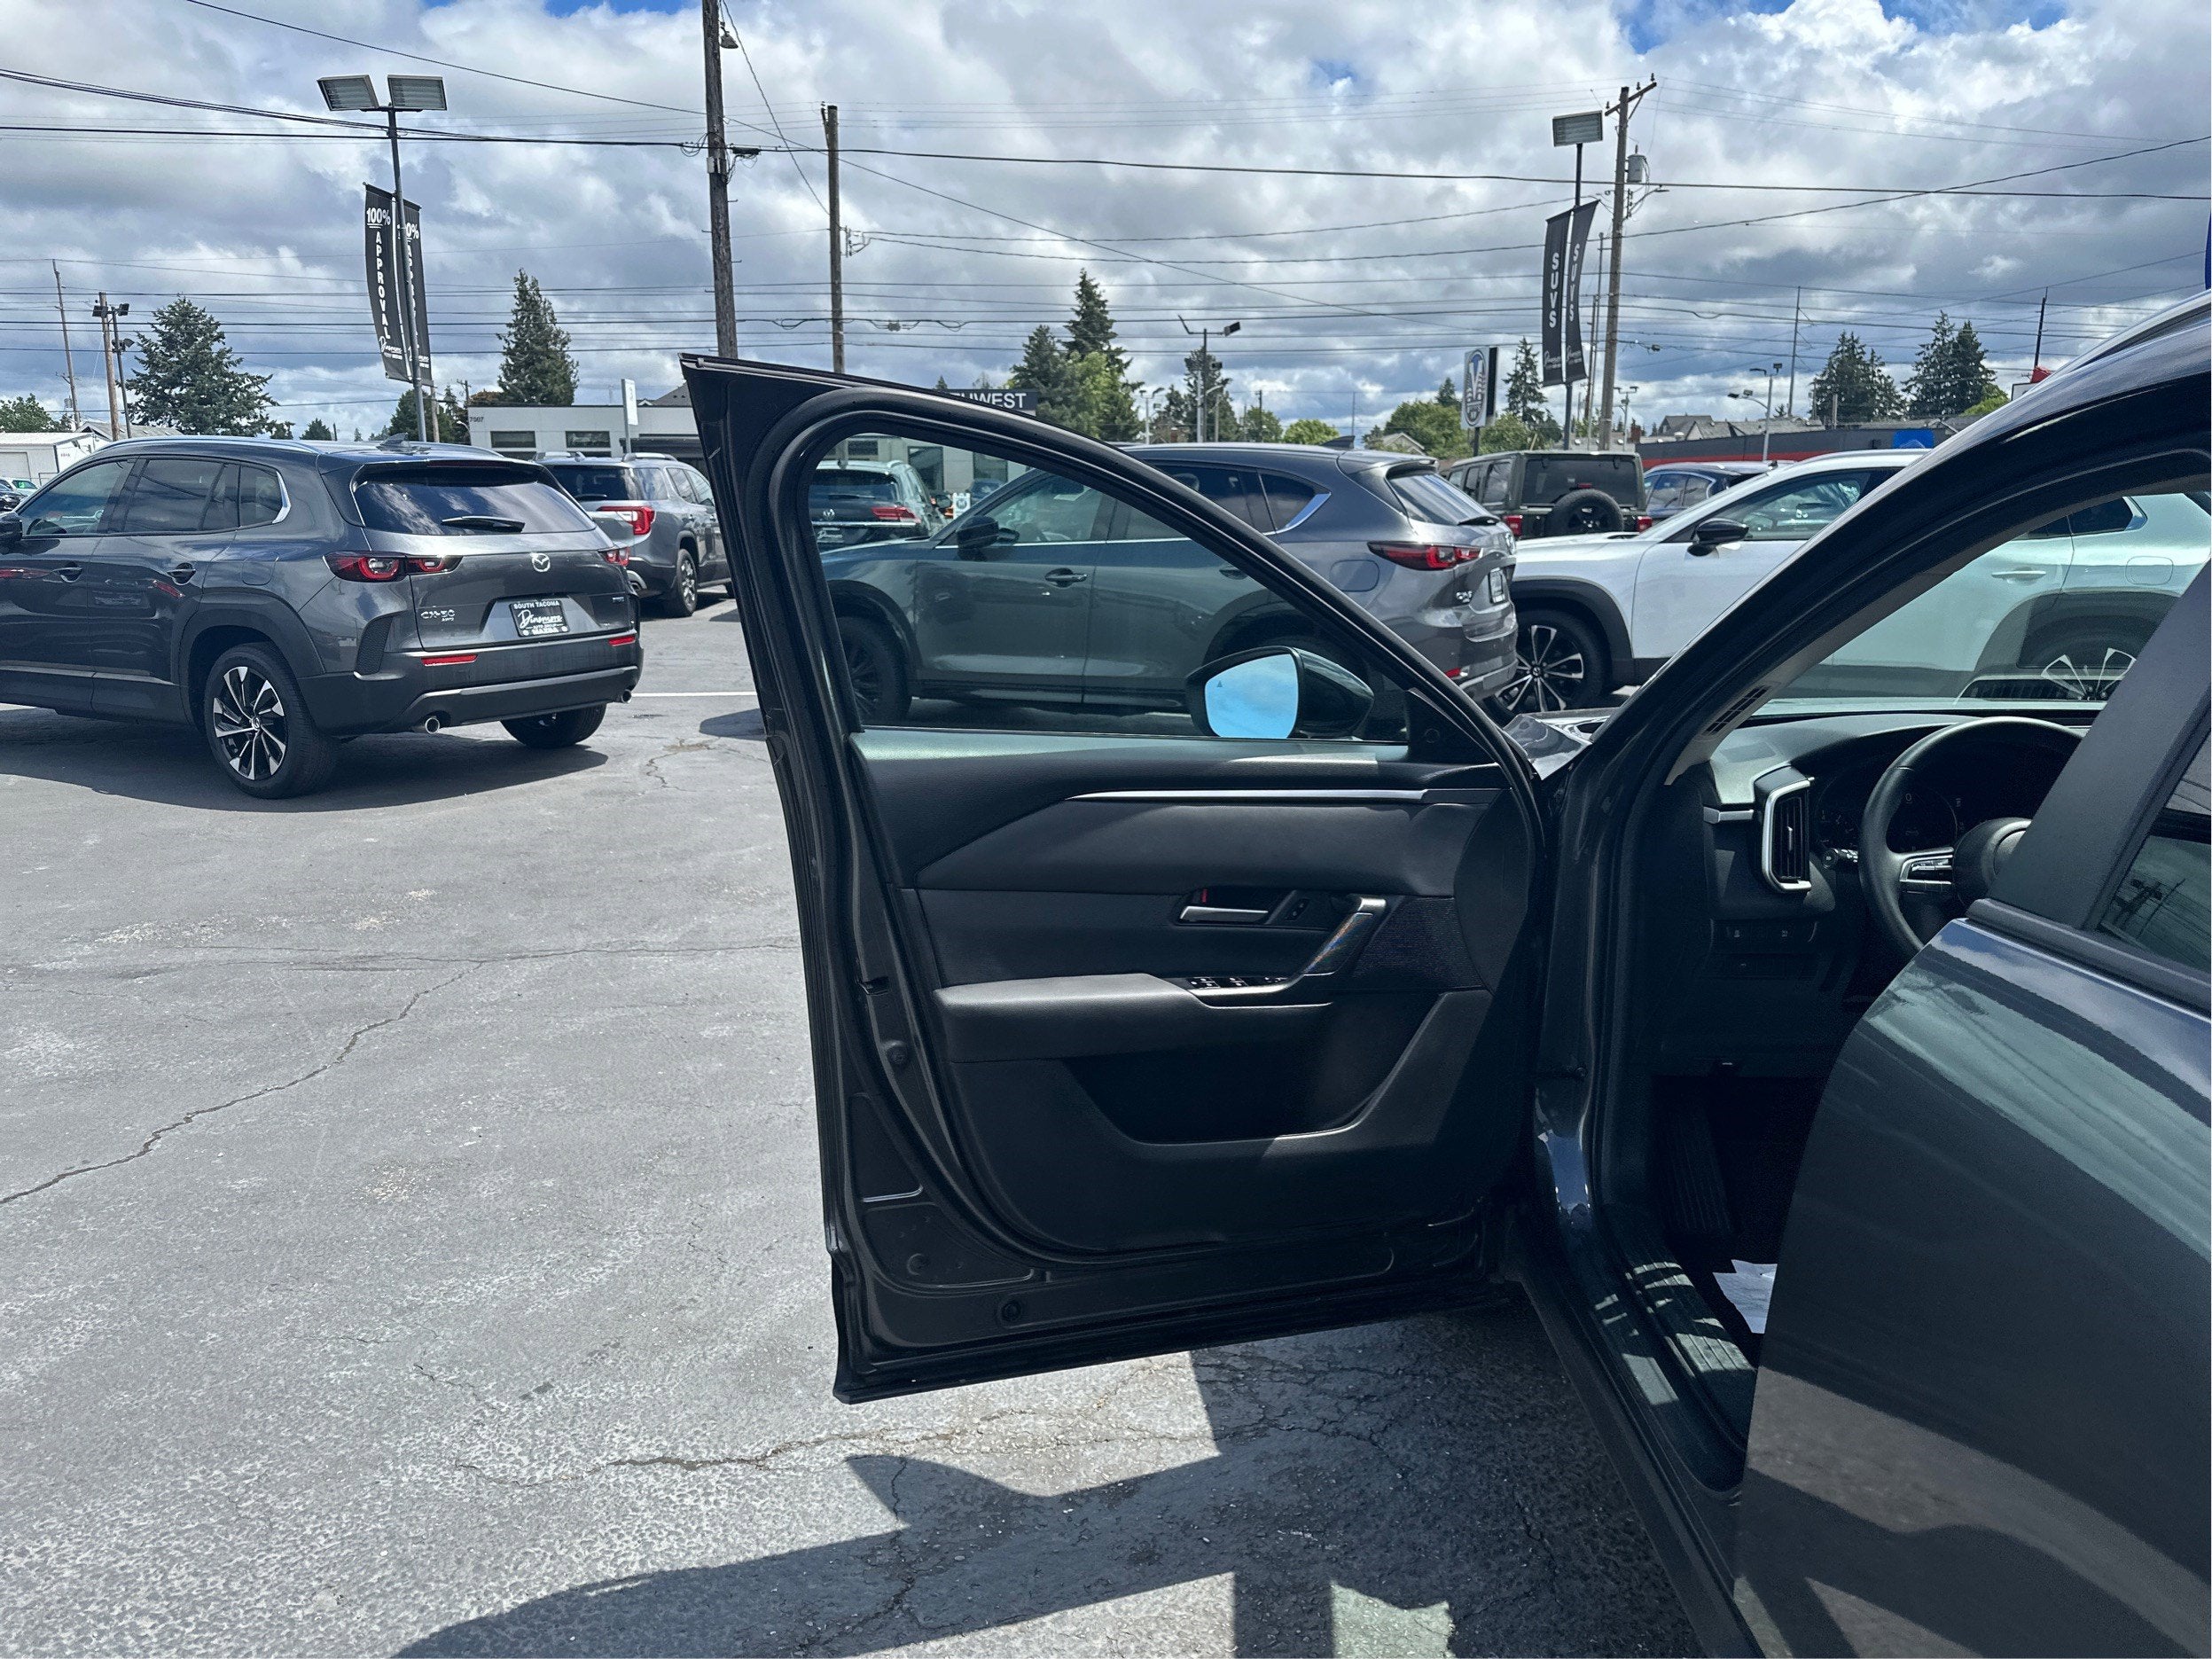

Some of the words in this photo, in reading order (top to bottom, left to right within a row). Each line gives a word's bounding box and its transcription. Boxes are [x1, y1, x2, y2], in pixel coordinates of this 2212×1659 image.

[366, 207, 391, 226] 100%
[376, 231, 391, 340] APPROVAL
[1549, 252, 1559, 328] SUVS
[1569, 243, 1580, 322] SUVS
